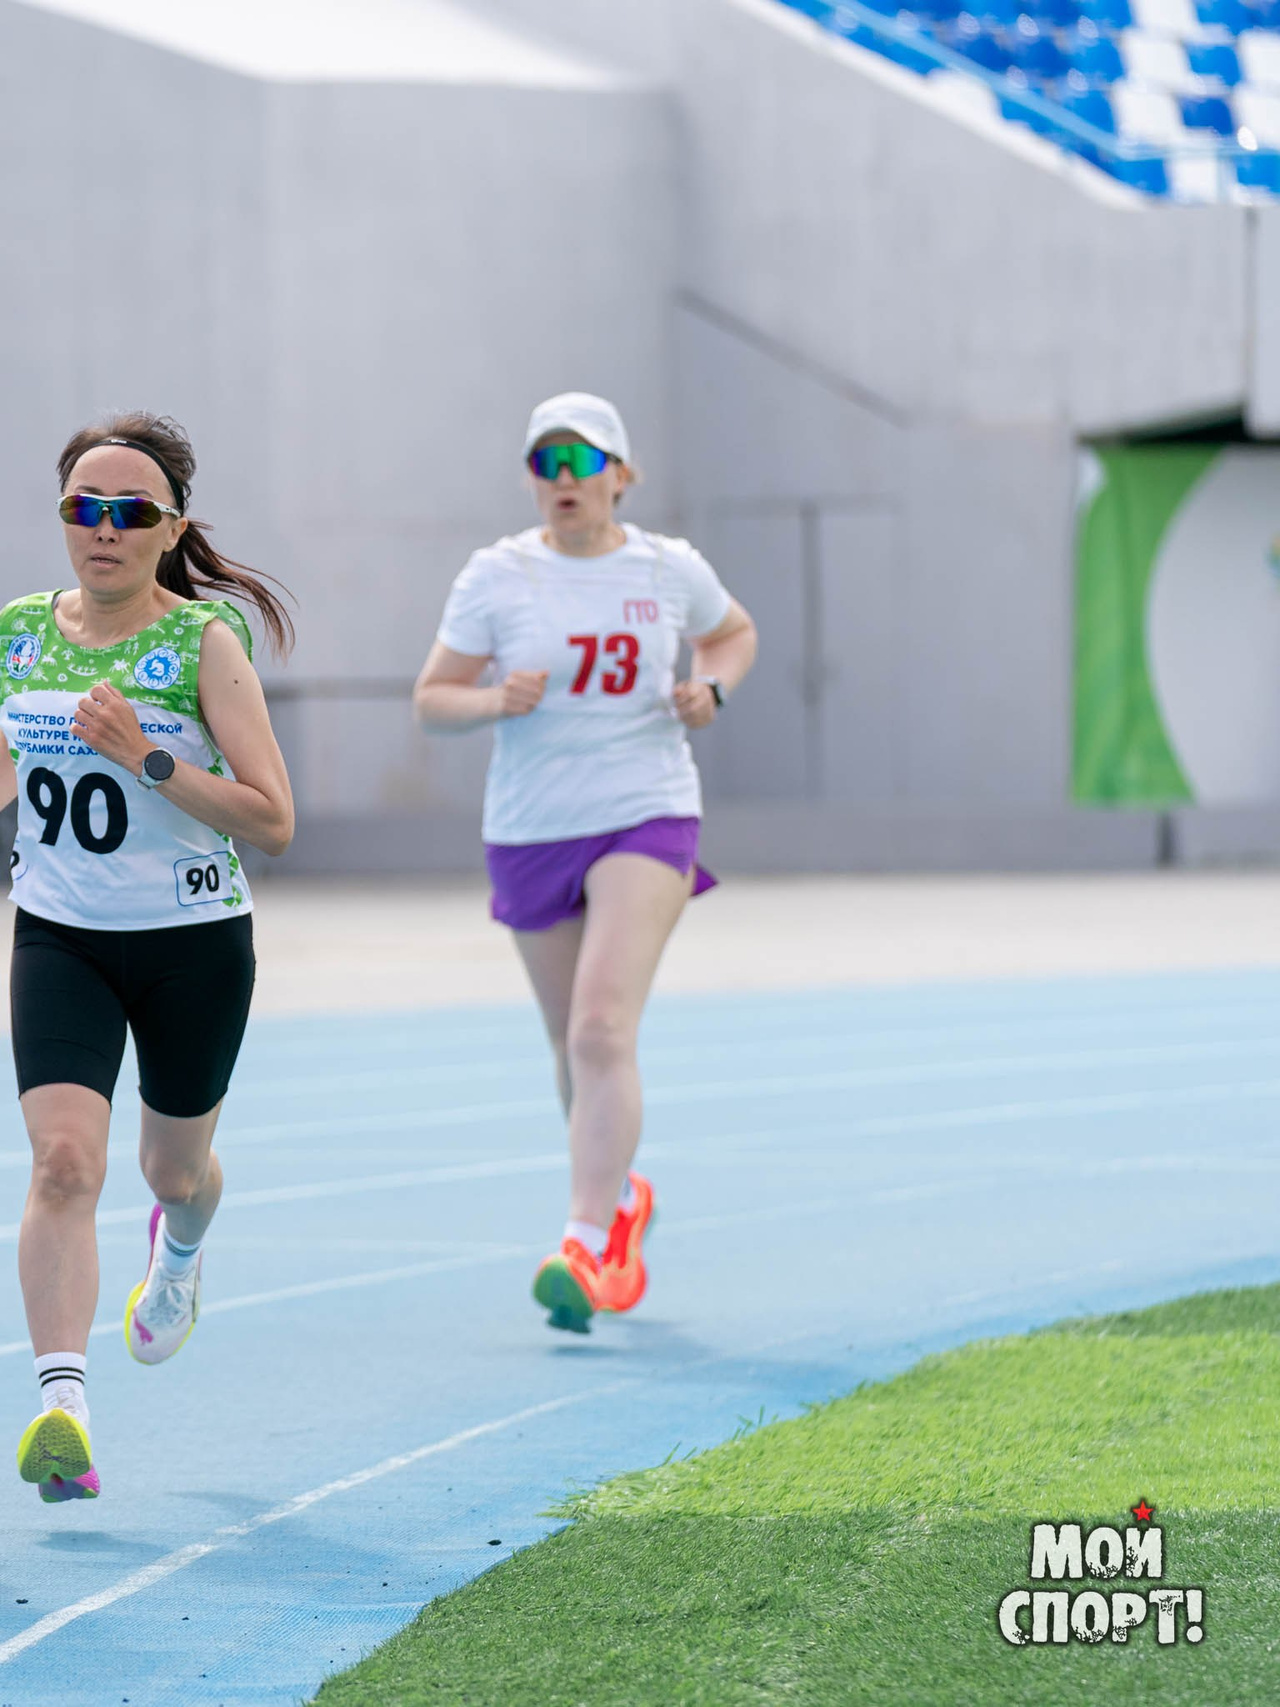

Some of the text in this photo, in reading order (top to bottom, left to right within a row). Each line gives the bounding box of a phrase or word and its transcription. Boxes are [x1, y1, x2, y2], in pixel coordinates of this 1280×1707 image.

[568, 634, 639, 695] 73
[68, 745, 98, 756] САХ
[27, 766, 129, 855] 90
[185, 864, 220, 895] 90
